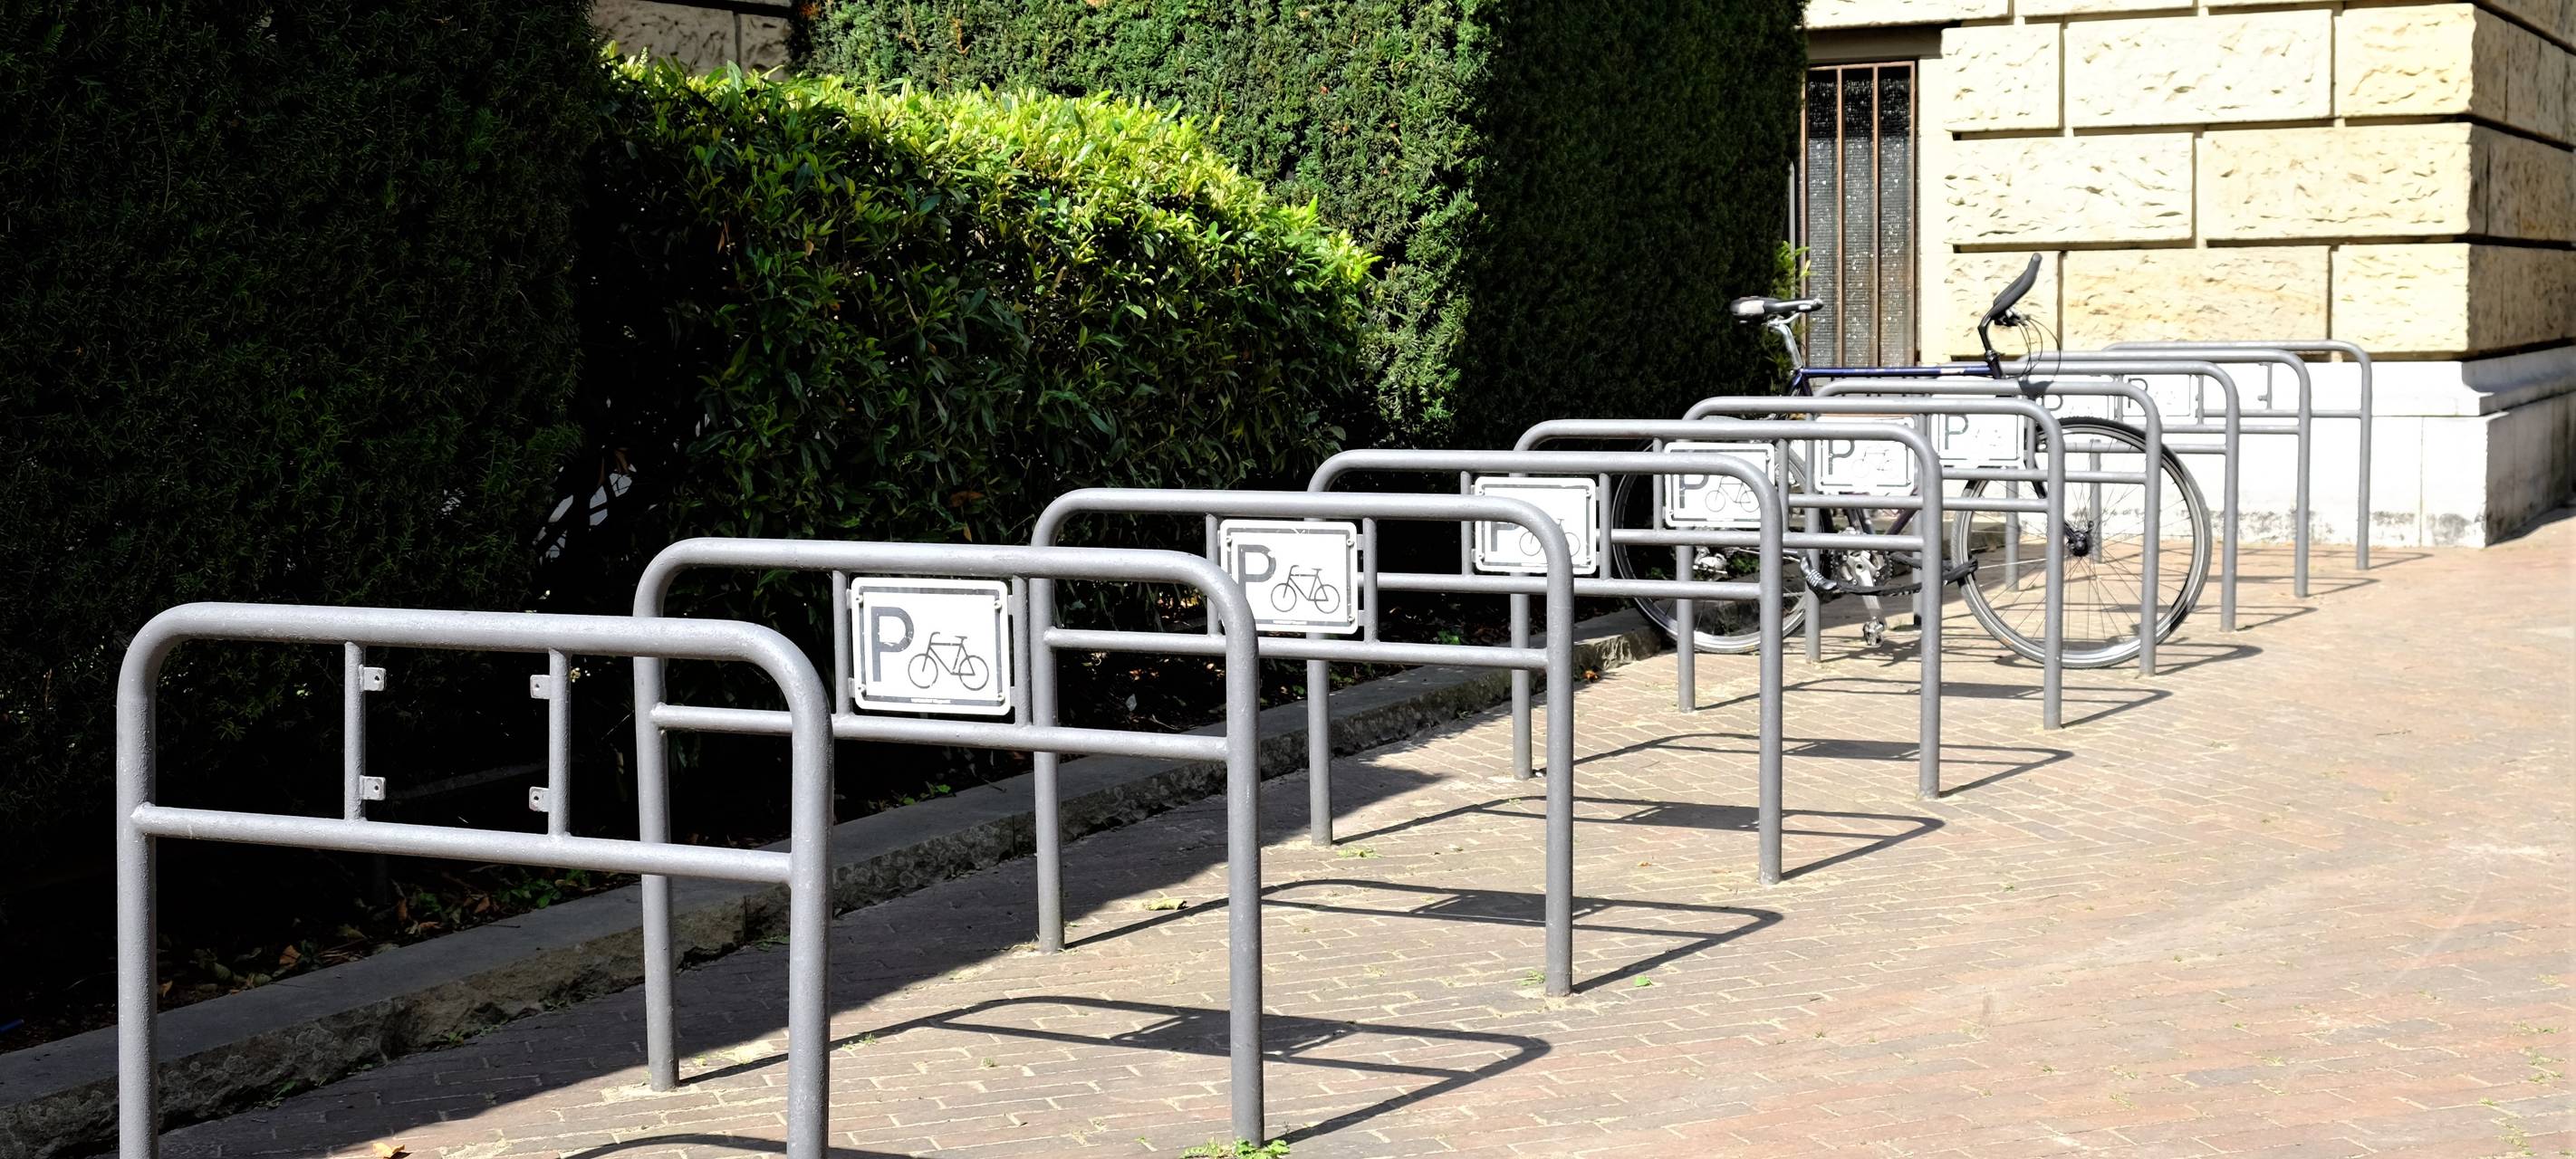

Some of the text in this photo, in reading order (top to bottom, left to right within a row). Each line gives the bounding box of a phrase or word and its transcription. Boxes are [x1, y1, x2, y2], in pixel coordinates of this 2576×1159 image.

[1946, 414, 1969, 450] P
[1828, 440, 1855, 475] P
[1237, 544, 1277, 598] P
[870, 606, 915, 682] P
